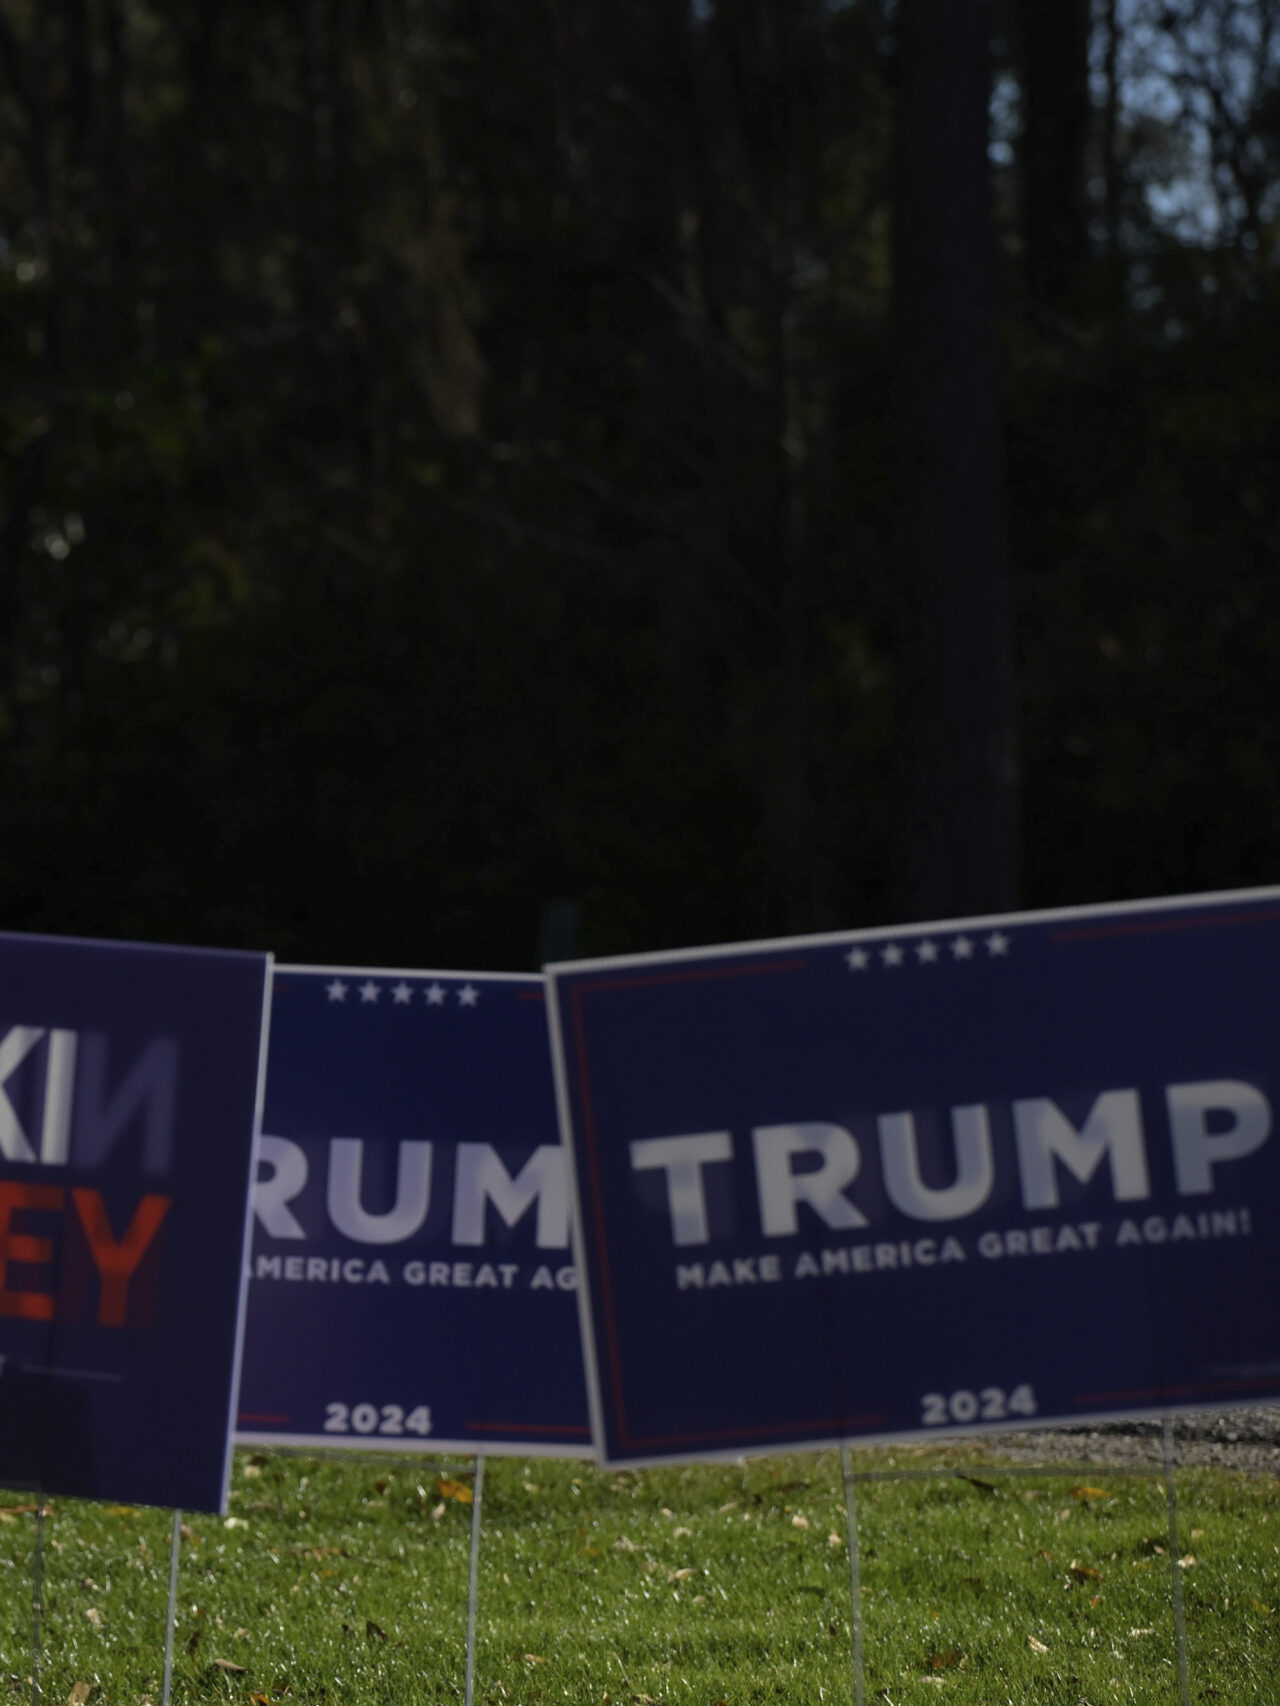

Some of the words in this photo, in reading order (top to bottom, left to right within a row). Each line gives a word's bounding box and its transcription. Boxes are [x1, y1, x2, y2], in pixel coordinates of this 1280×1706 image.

[630, 1080, 1273, 1247] TRUMP
[676, 1256, 781, 1292] MAKE
[794, 1240, 965, 1279] AMERICA
[978, 1223, 1101, 1260] GREAT
[1116, 1209, 1252, 1246] AGAIN!
[245, 1256, 391, 1285] MERICA
[403, 1261, 518, 1290] GREAT
[324, 1403, 433, 1435] 2024
[921, 1385, 1038, 1425] 2024
